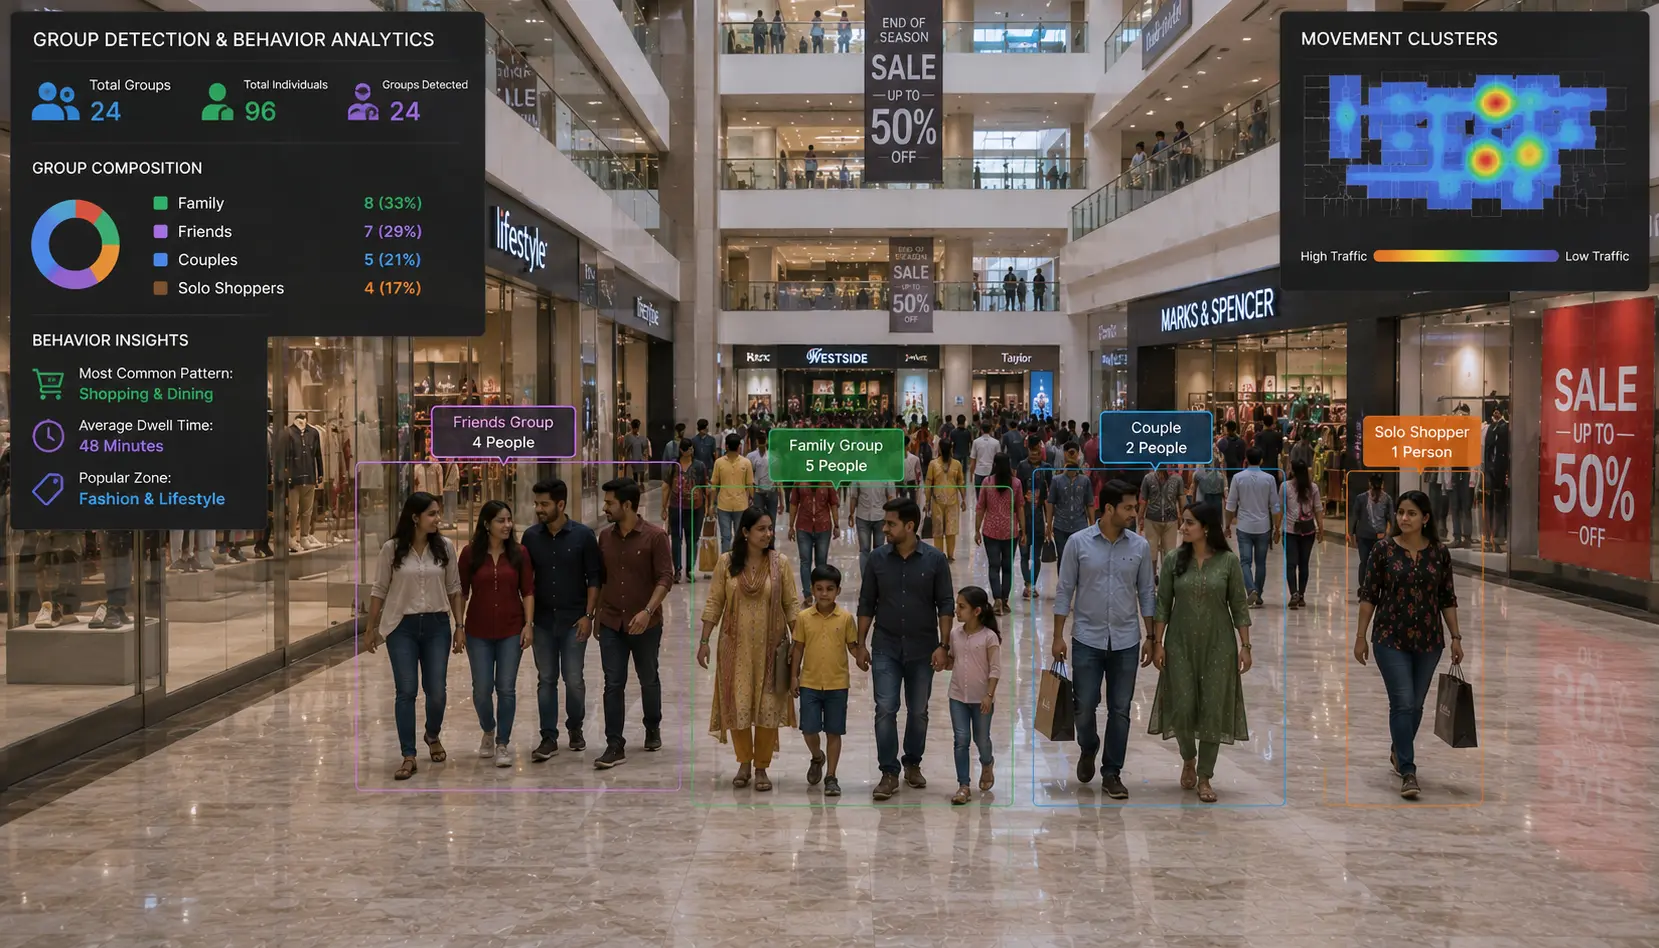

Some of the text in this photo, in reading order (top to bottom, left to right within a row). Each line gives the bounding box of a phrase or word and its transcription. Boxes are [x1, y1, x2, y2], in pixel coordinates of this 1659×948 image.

[883, 17, 925, 28] END OF
[880, 32, 928, 42] SEASON
[872, 54, 935, 80] SALE
[888, 90, 919, 101] UP TO
[871, 108, 936, 145] 50%
[892, 151, 916, 163] OFF
[497, 206, 547, 272] lifestyle
[894, 265, 929, 279] SALE
[892, 294, 929, 313] 50%
[1162, 288, 1273, 331] MARKS & SPENCER
[806, 348, 867, 364] WESTSIDE
[1555, 366, 1638, 411] SALE
[1574, 423, 1614, 445] UP TO
[1553, 453, 1635, 522] 50%
[1580, 526, 1605, 548] OFF
